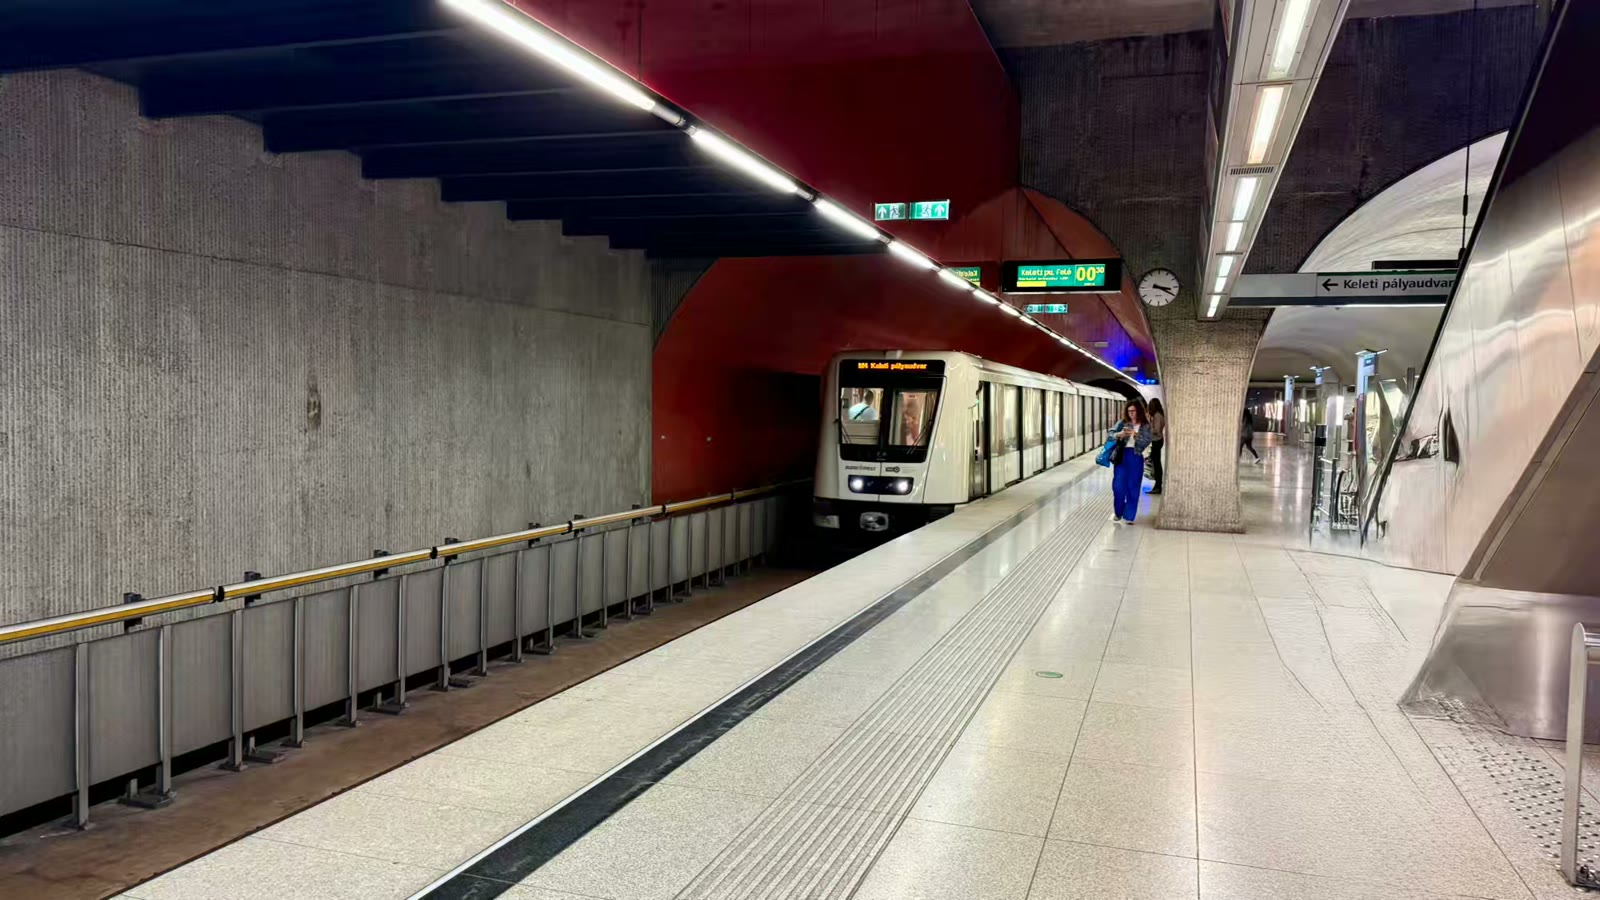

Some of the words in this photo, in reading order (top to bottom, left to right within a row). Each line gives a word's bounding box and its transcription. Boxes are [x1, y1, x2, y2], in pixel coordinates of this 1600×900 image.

[1076, 267, 1096, 281] 00
[1343, 278, 1378, 289] Keleti
[1382, 277, 1454, 291] pályaudvar
